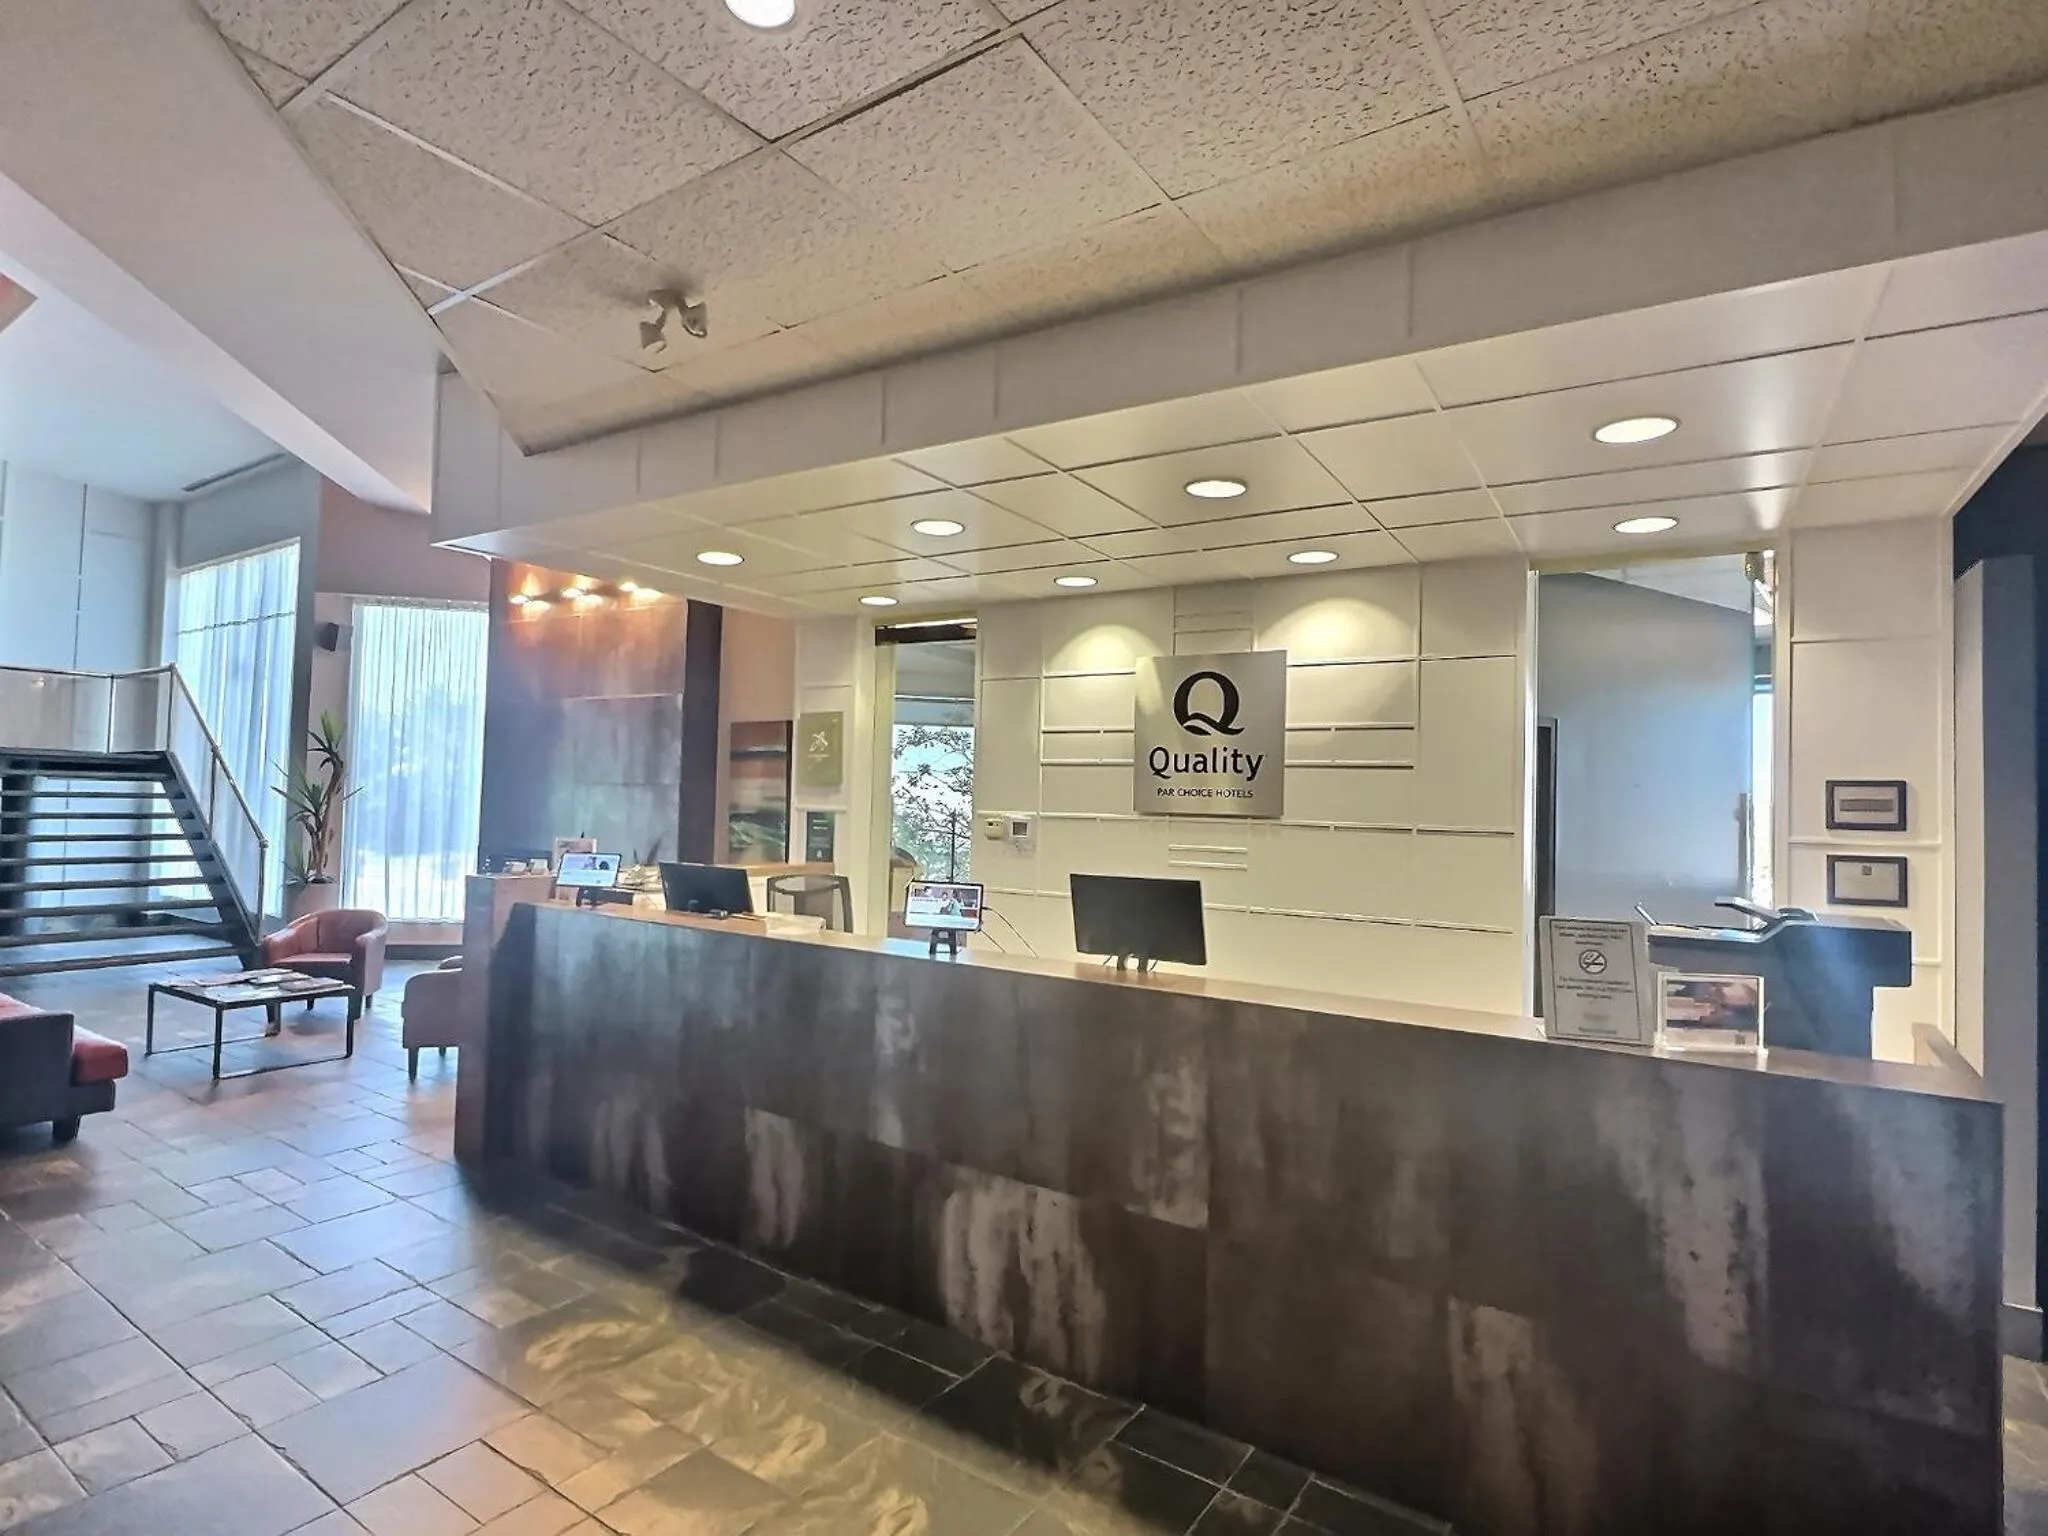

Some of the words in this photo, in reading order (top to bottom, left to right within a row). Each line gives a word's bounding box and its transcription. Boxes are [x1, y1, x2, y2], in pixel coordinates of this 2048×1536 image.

[1173, 671, 1245, 736] Q
[1149, 746, 1264, 781] Quality
[1157, 787, 1175, 796] PAR
[1177, 788, 1213, 797] CHOICE
[1216, 789, 1254, 798] HOTELS
